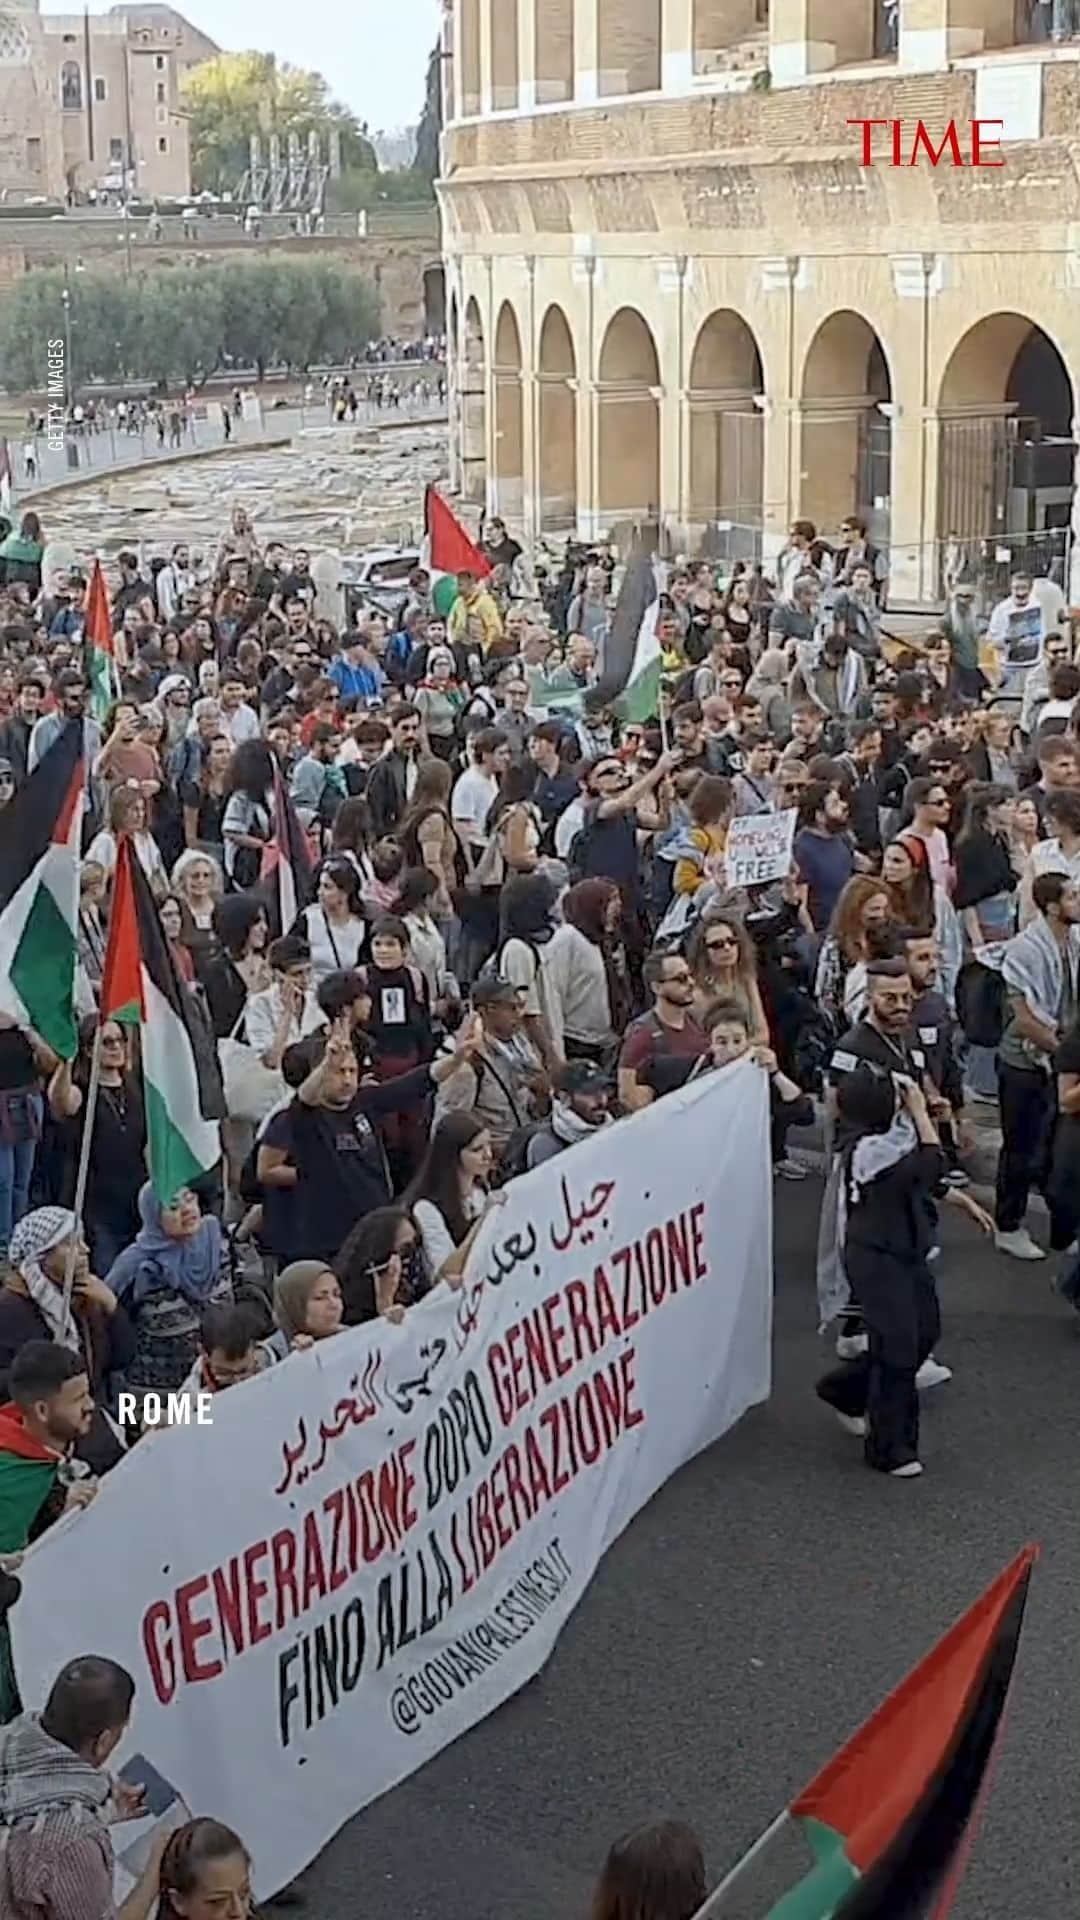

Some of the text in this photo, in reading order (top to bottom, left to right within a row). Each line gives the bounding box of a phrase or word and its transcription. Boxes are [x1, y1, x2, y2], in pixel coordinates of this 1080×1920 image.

[735, 859, 777, 882] FREE
[550, 1172, 615, 1251] جيل
[486, 1221, 541, 1286] بعد
[142, 1201, 708, 1705] GENERAZIONE DOPO GENERAZIONE
[279, 1346, 645, 1748] FINO ALLA LIBERAZIONE
